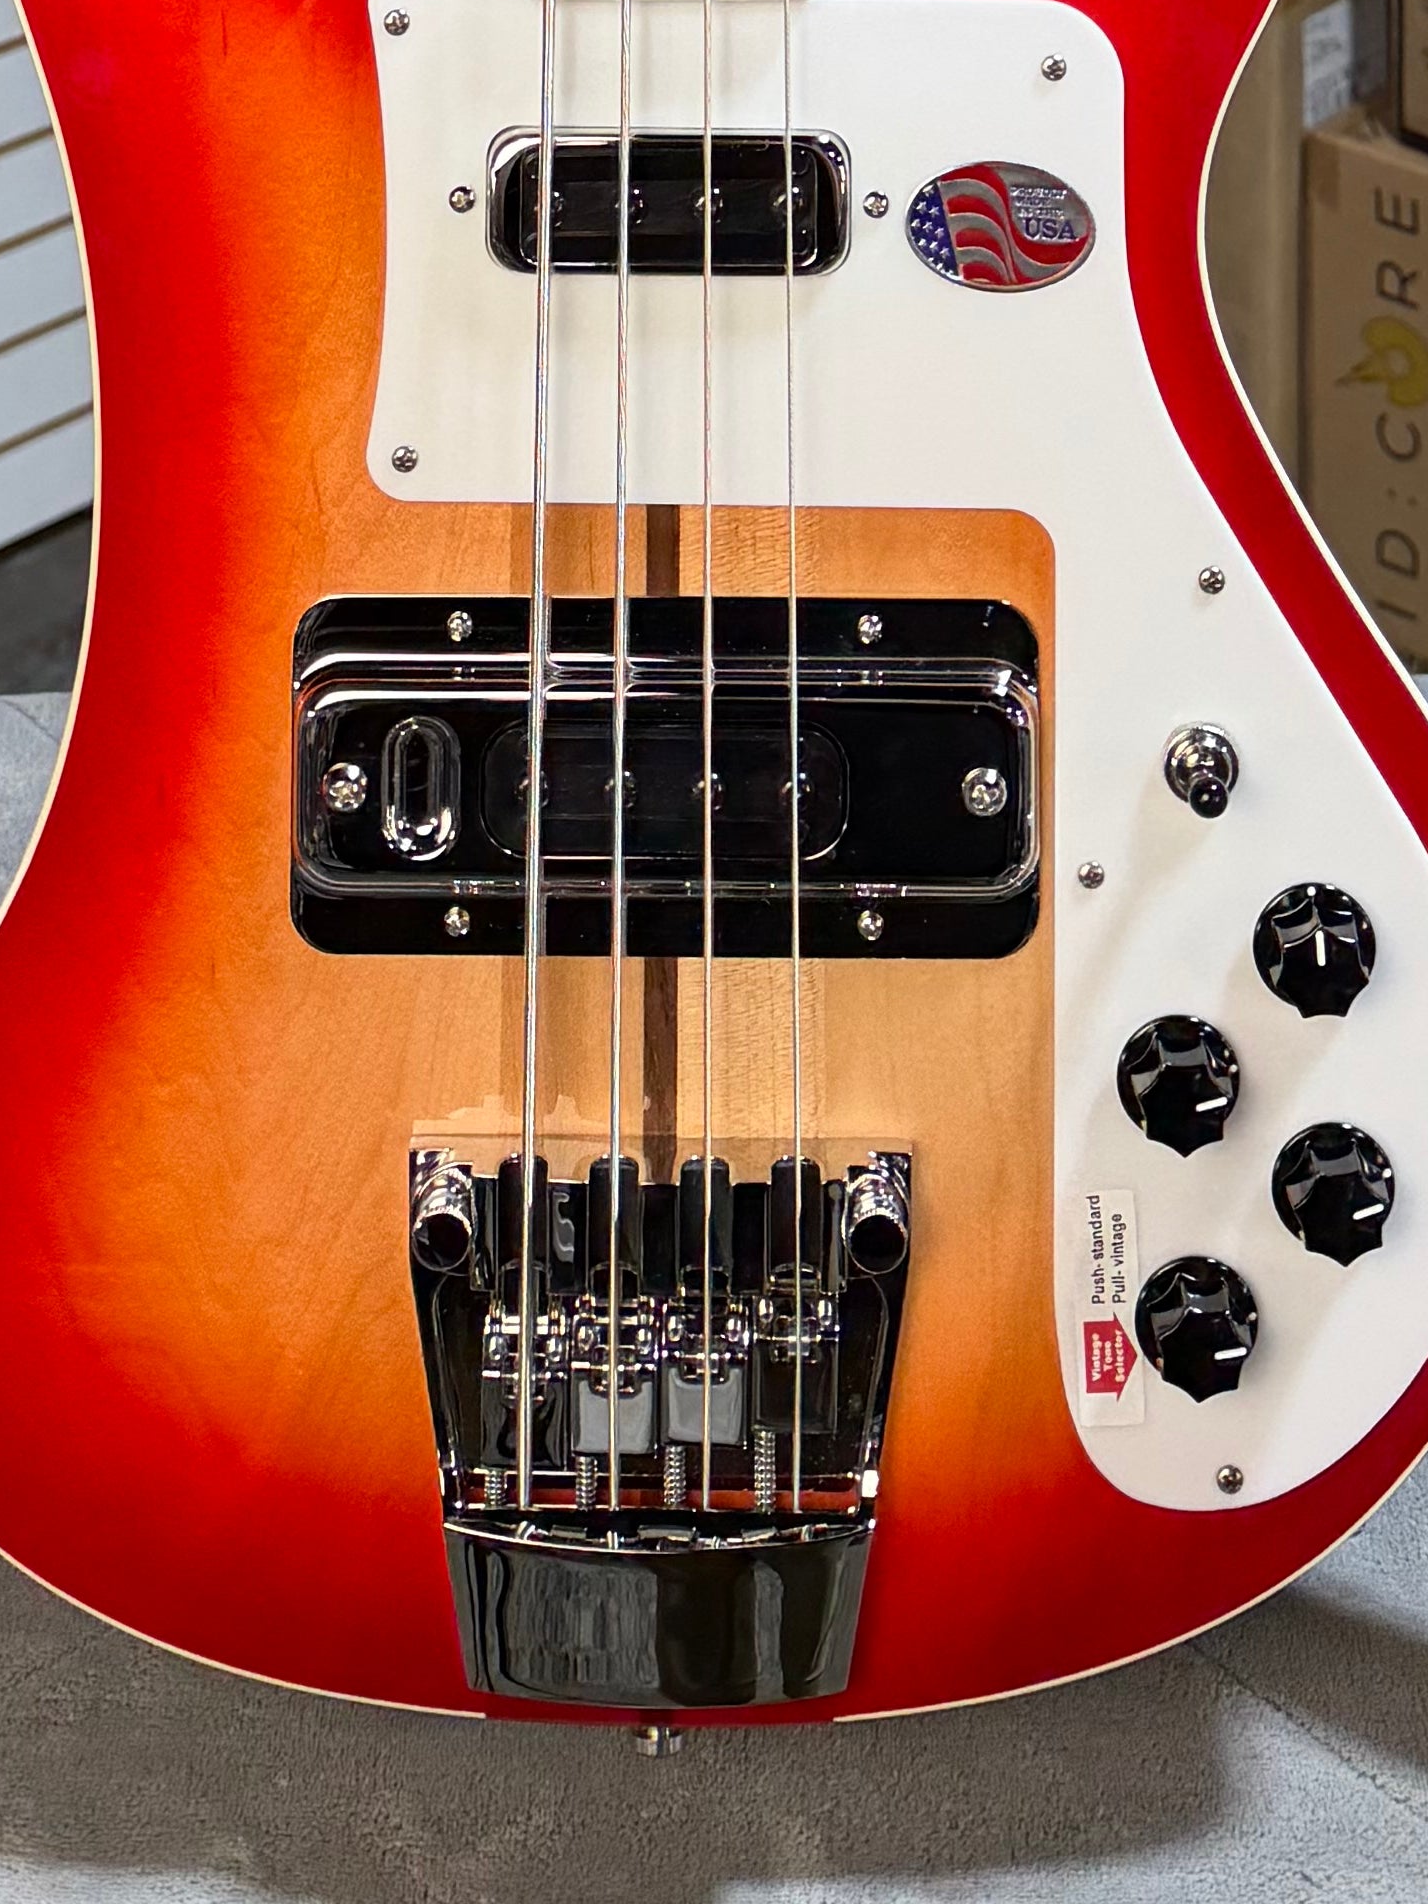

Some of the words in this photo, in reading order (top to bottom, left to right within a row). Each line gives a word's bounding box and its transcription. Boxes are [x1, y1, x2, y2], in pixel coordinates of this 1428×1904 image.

[1025, 217, 1079, 240] USA
[1086, 1194, 1103, 1260] standard
[1110, 1212, 1127, 1267] vintage
[1091, 1264, 1105, 1305] Push-
[1112, 1270, 1127, 1304] Pull-
[1091, 1332, 1103, 1382] Vintage
[1102, 1340, 1114, 1372] Tone
[1114, 1328, 1125, 1383] Selector
